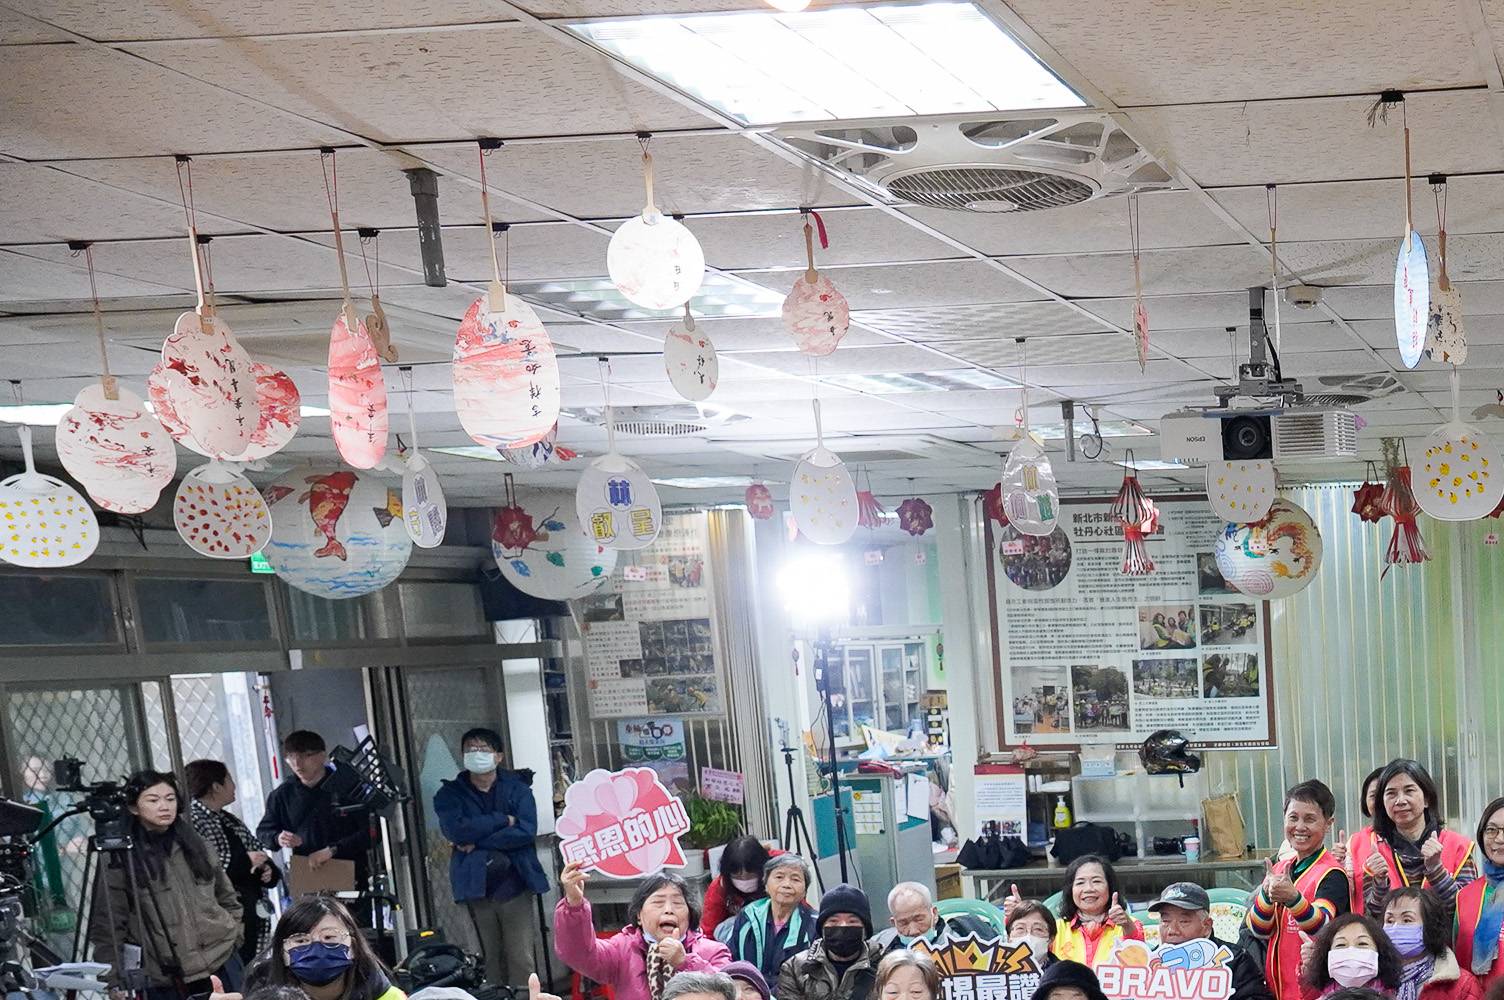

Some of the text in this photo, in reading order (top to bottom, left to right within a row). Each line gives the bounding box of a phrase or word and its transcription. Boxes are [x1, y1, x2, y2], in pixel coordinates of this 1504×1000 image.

[563, 801, 688, 868] 感恩的心
[1100, 965, 1229, 1000] BRAVO
